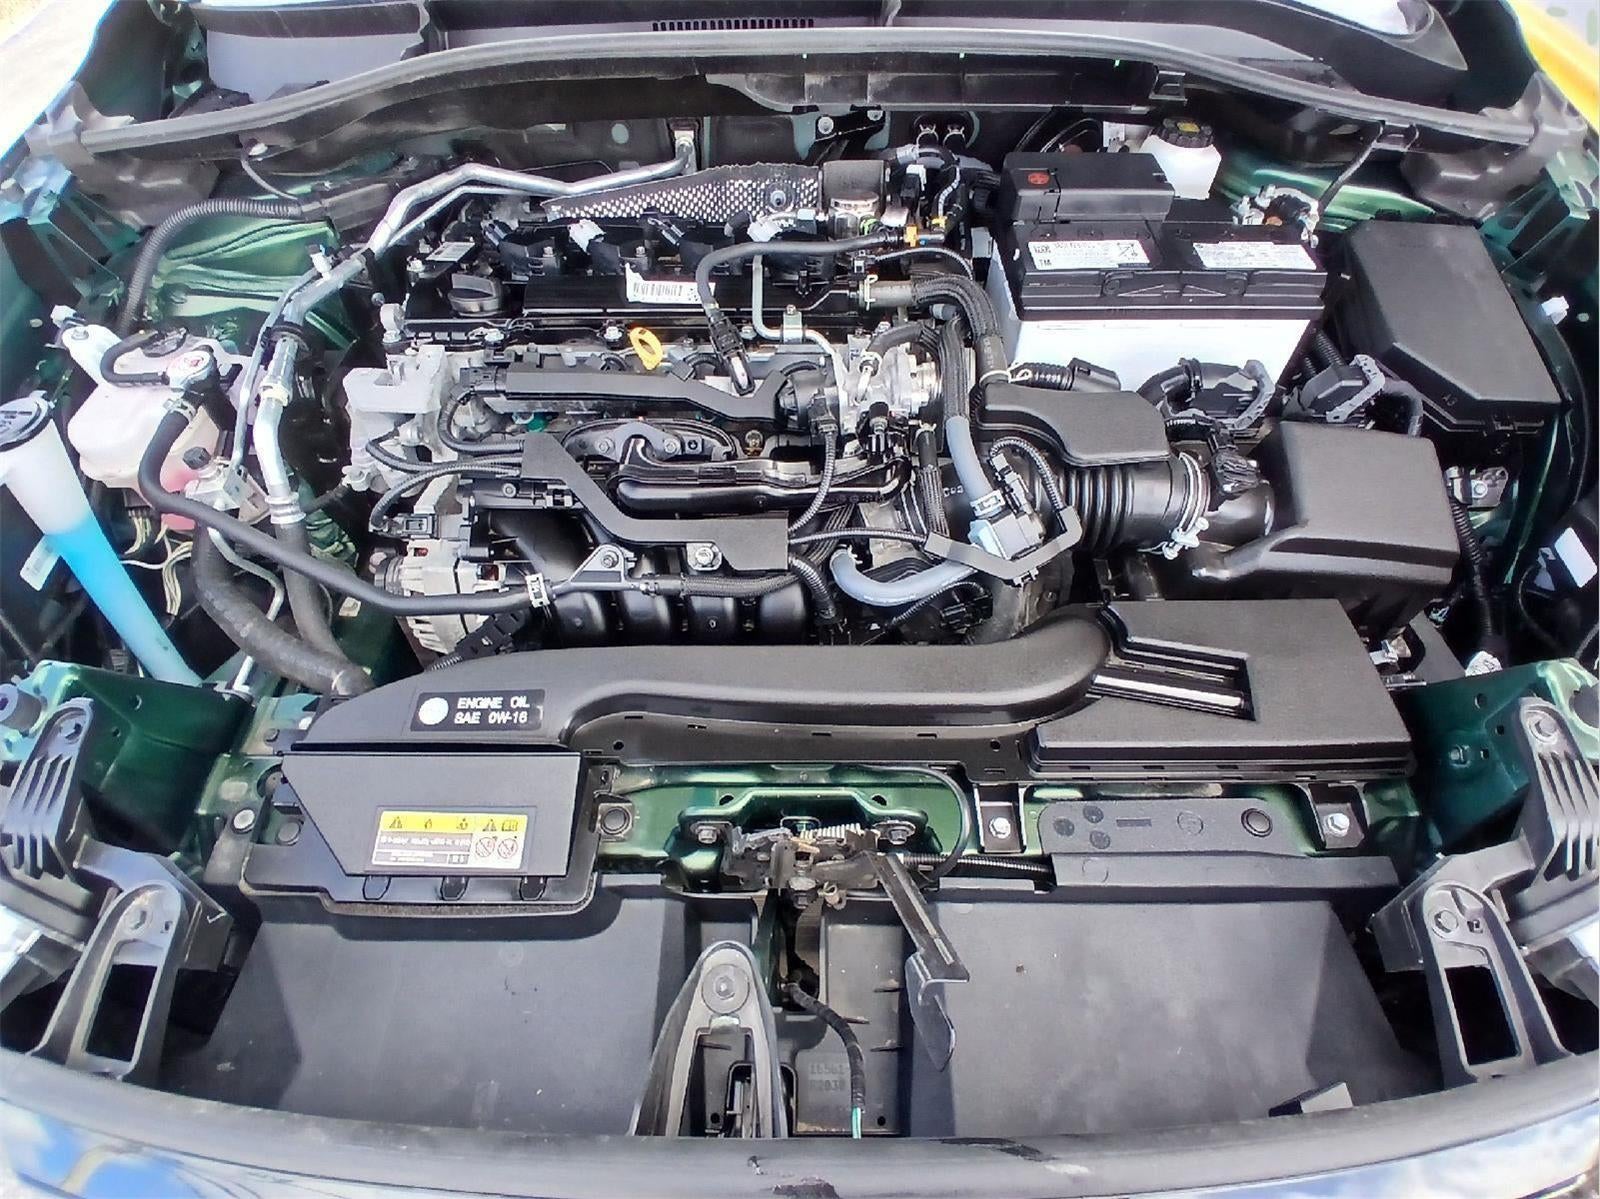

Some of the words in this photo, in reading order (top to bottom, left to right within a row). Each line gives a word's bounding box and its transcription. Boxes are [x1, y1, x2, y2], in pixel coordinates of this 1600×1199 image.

[457, 696, 503, 709] ENGINE
[510, 695, 530, 709] OIL
[454, 711, 481, 724] SAE
